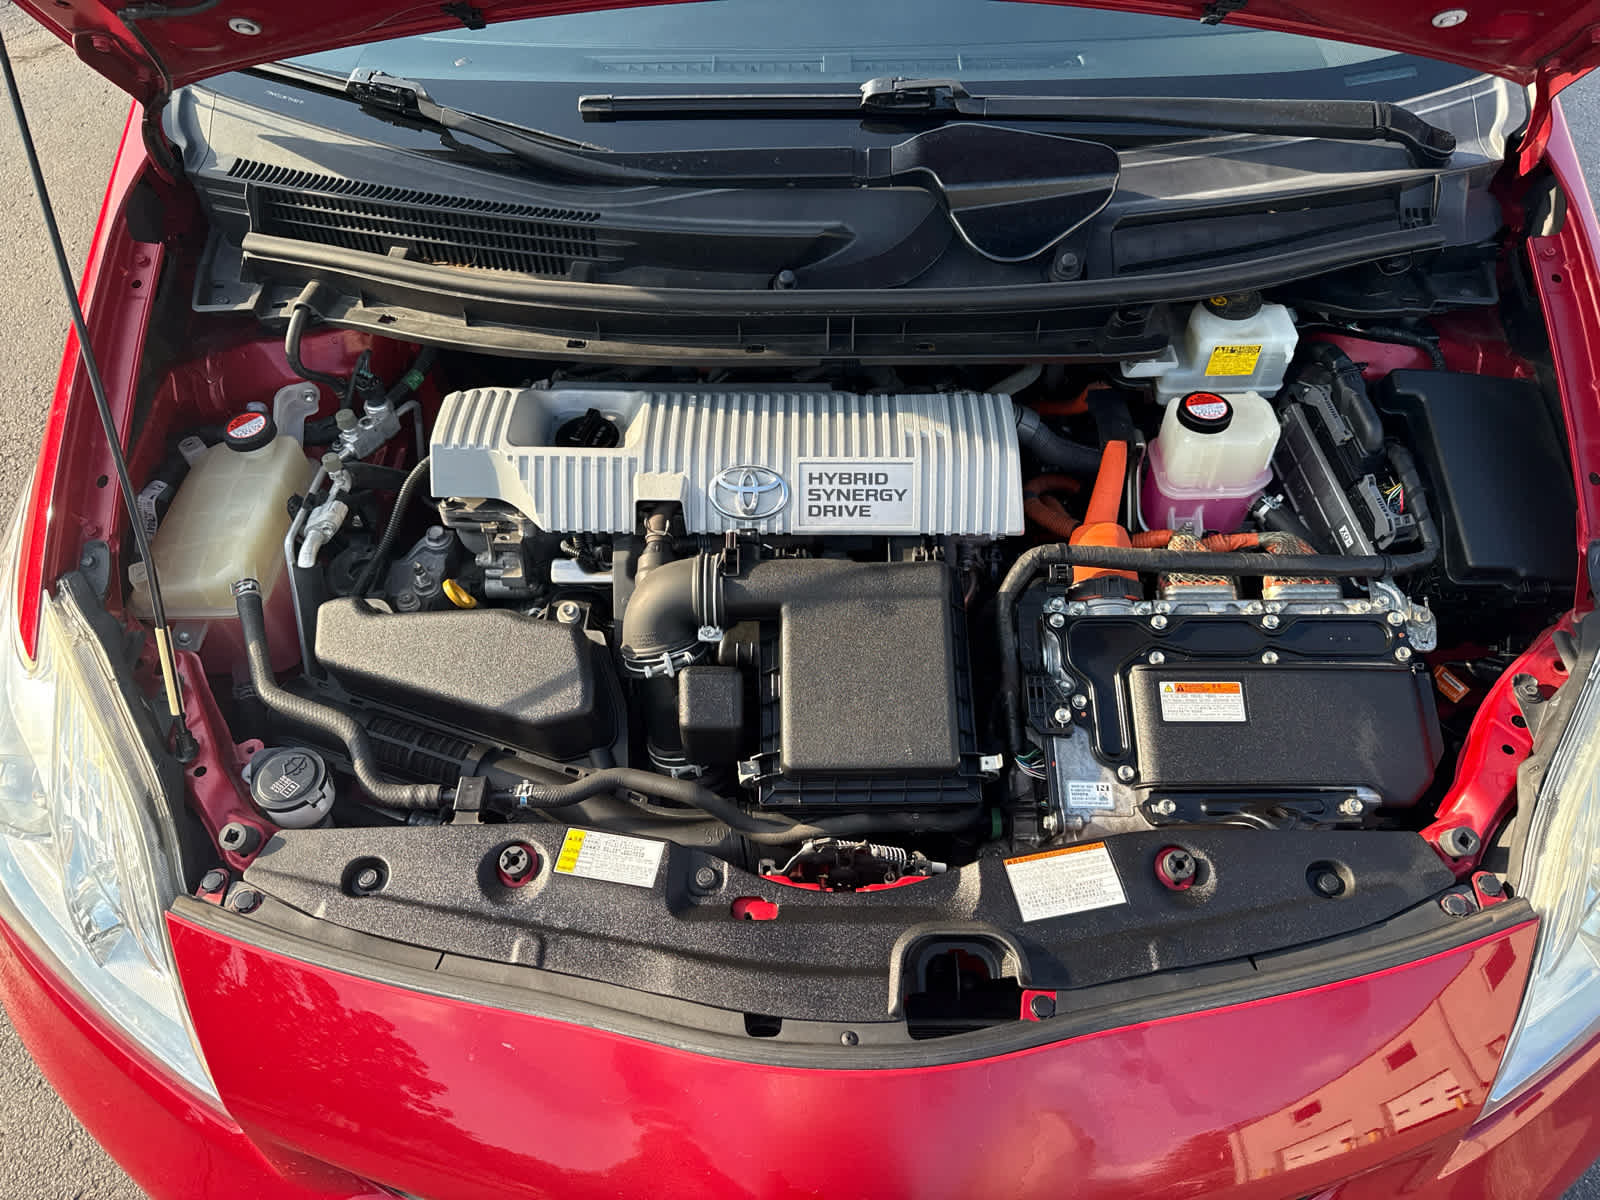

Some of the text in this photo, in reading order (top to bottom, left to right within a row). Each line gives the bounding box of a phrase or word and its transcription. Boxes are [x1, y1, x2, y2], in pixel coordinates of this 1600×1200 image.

[808, 472, 889, 486] HYBRID
[808, 488, 908, 502] SYNERGY
[808, 505, 872, 518] DRIVE
